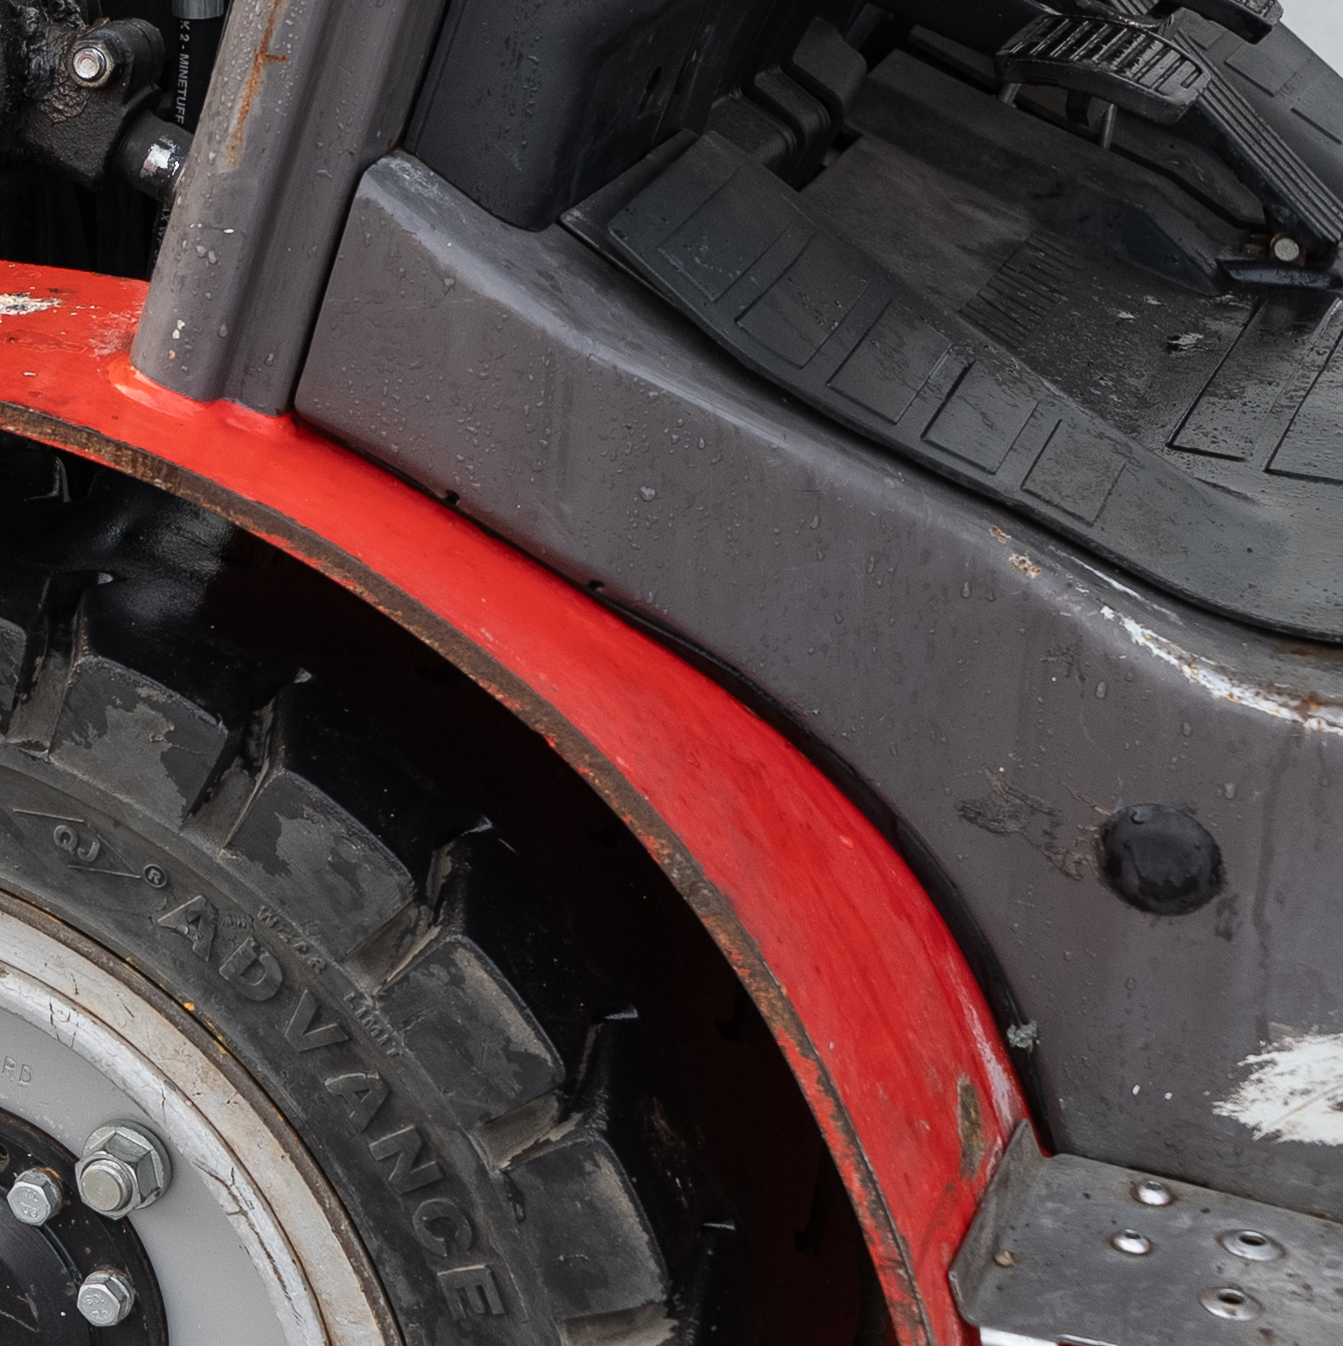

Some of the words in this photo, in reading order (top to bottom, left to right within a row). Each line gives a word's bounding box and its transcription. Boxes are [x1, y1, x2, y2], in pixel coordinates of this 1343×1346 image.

[179, 34, 190, 42] 2
[175, 53, 189, 124] MINETUFF
[157, 895, 505, 1321] ADVANCE
